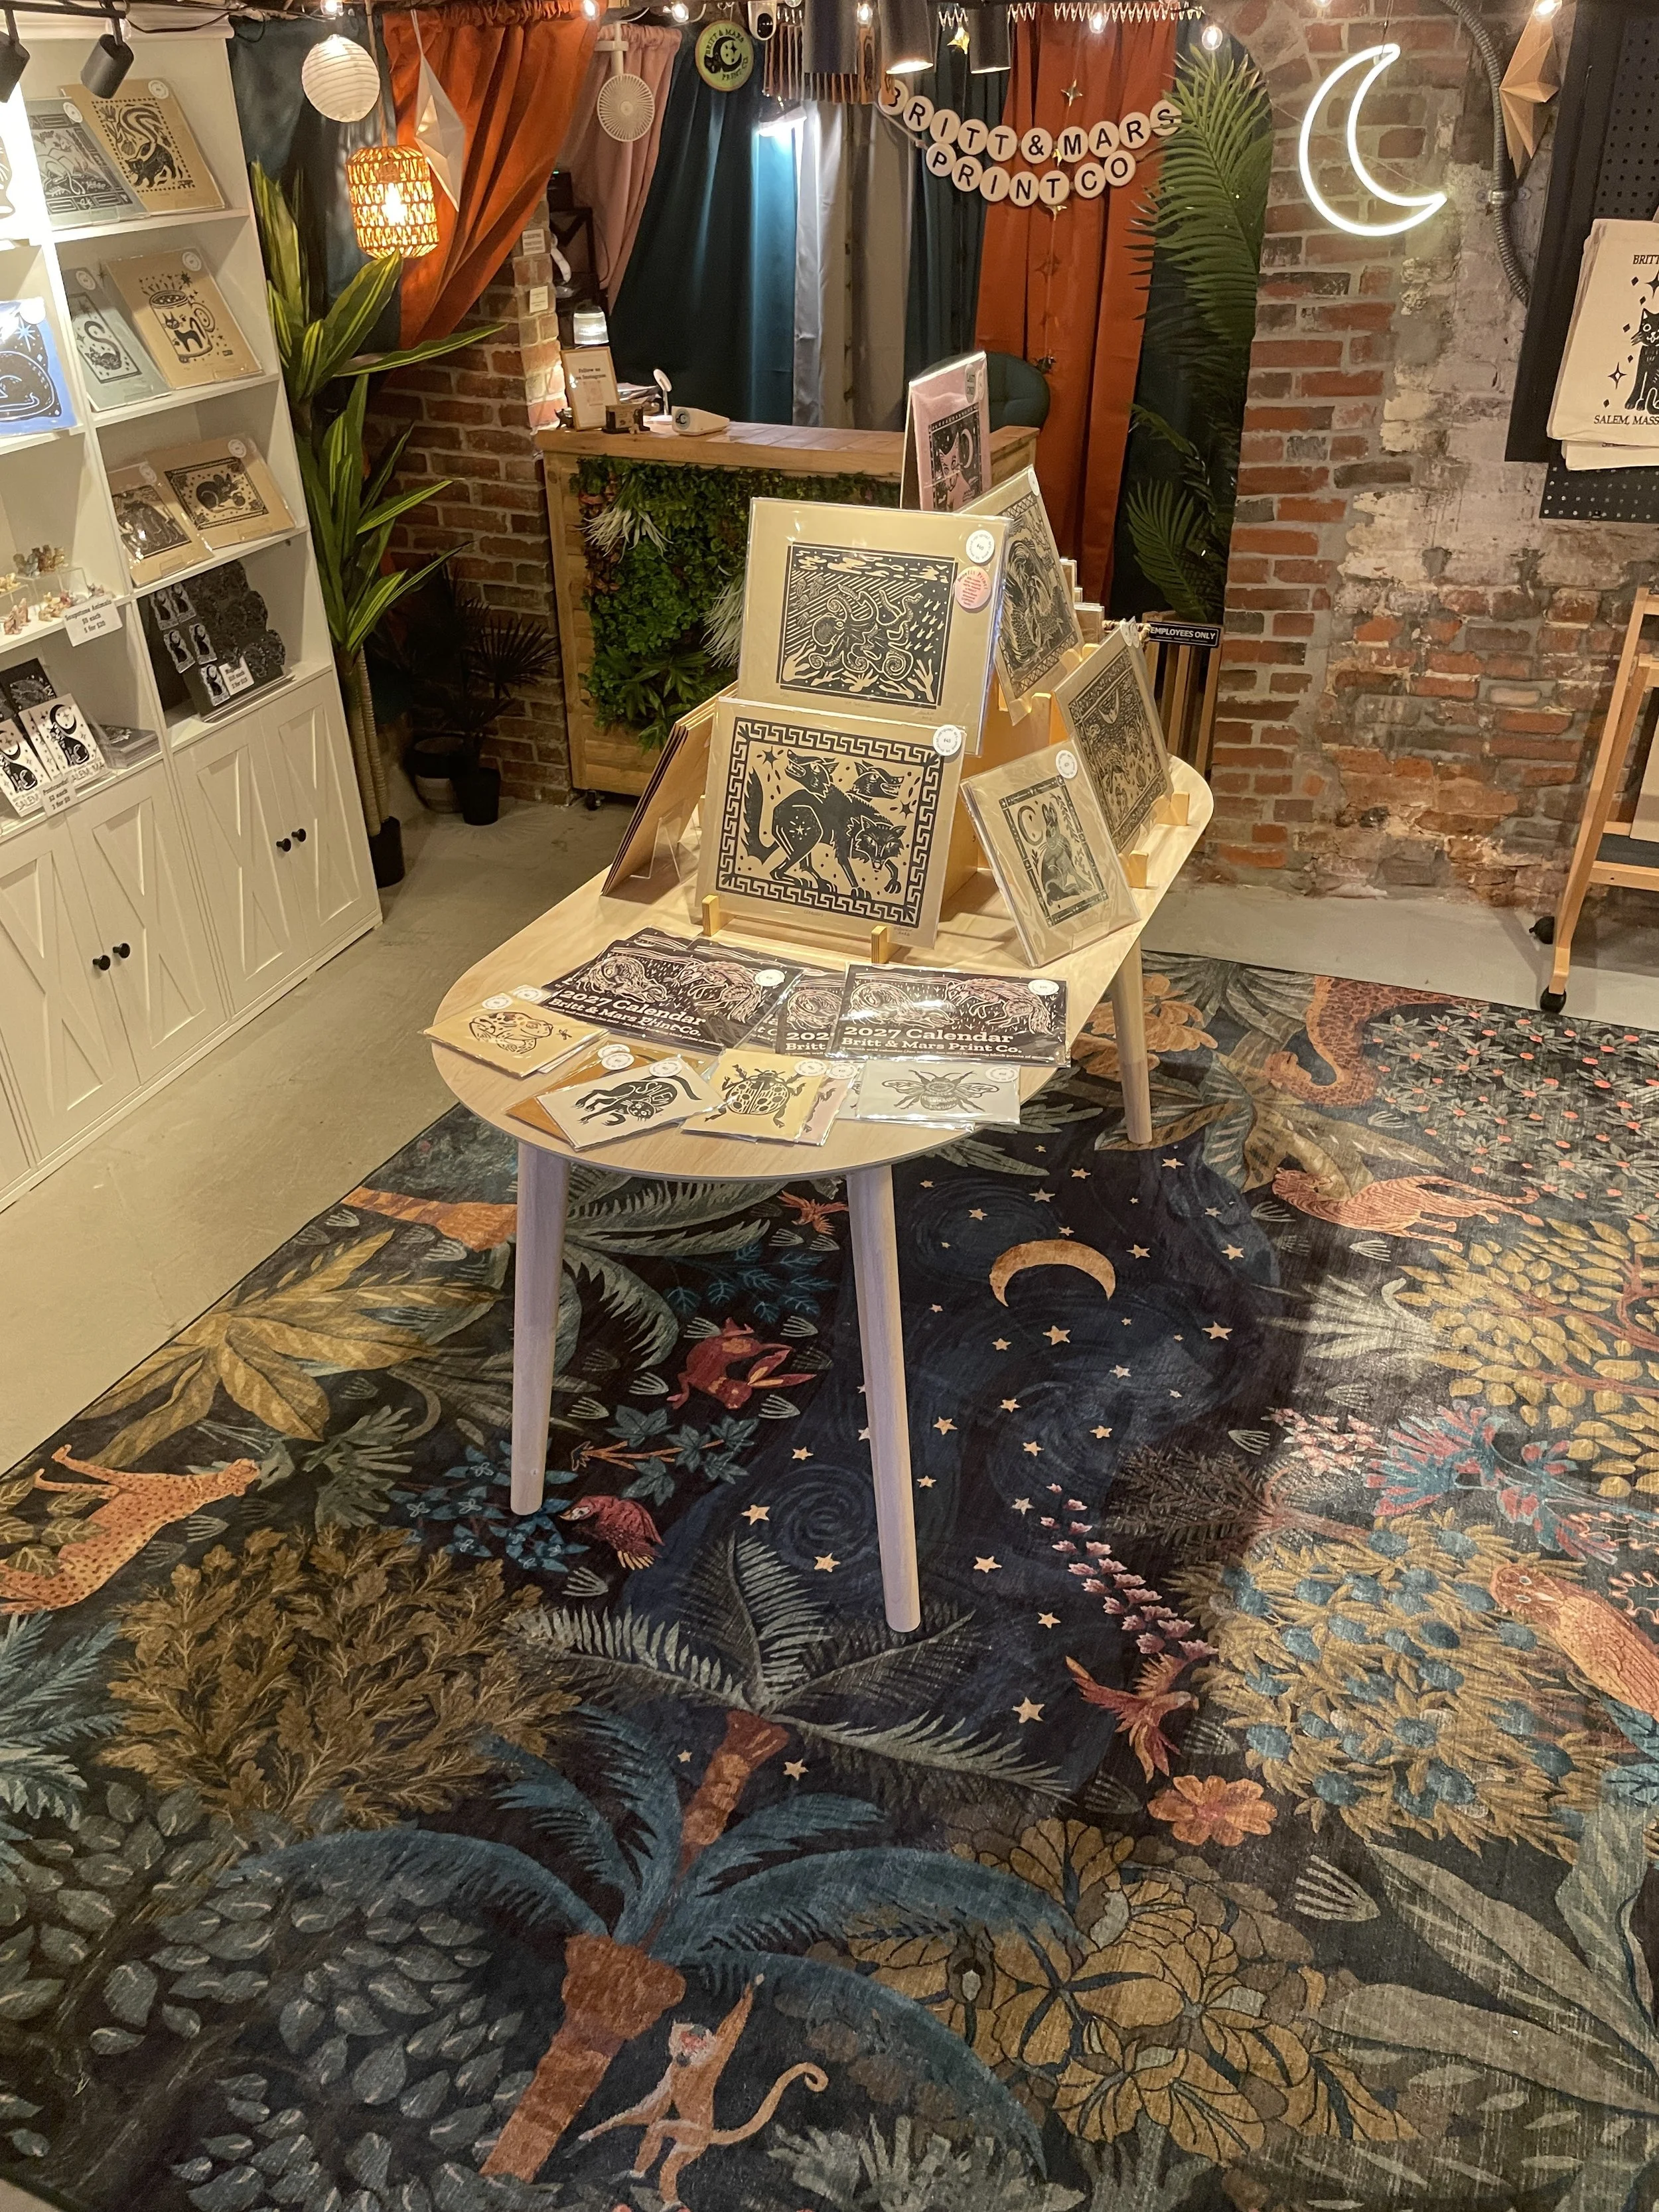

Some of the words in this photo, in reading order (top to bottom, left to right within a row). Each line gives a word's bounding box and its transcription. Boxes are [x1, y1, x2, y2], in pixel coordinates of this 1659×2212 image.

[1028, 134, 1045, 156] &
[1063, 108, 1175, 155] MARS
[932, 153, 1060, 200] PRINT
[1080, 156, 1128, 191] CO
[1594, 415, 1630, 425] SALEM,
[1150, 627, 1193, 637] EMPLOYEES
[1194, 631, 1216, 640] ONLY
[548, 998, 585, 1011] Britt
[598, 1009, 637, 1022] Mars
[638, 1016, 678, 1031] Print
[679, 1025, 701, 1036] Co.
[559, 990, 613, 1006] 2027
[612, 1000, 706, 1025] Calendar
[786, 1032, 832, 1041] 202
[841, 1037, 881, 1047] Britt
[901, 1041, 944, 1049] Mars
[948, 1043, 993, 1051] Print
[995, 1045, 1022, 1053] Co.
[843, 1027, 901, 1039] 2027
[906, 1028, 1013, 1043] Calendar
[635, 1082, 673, 1106] SALEM
